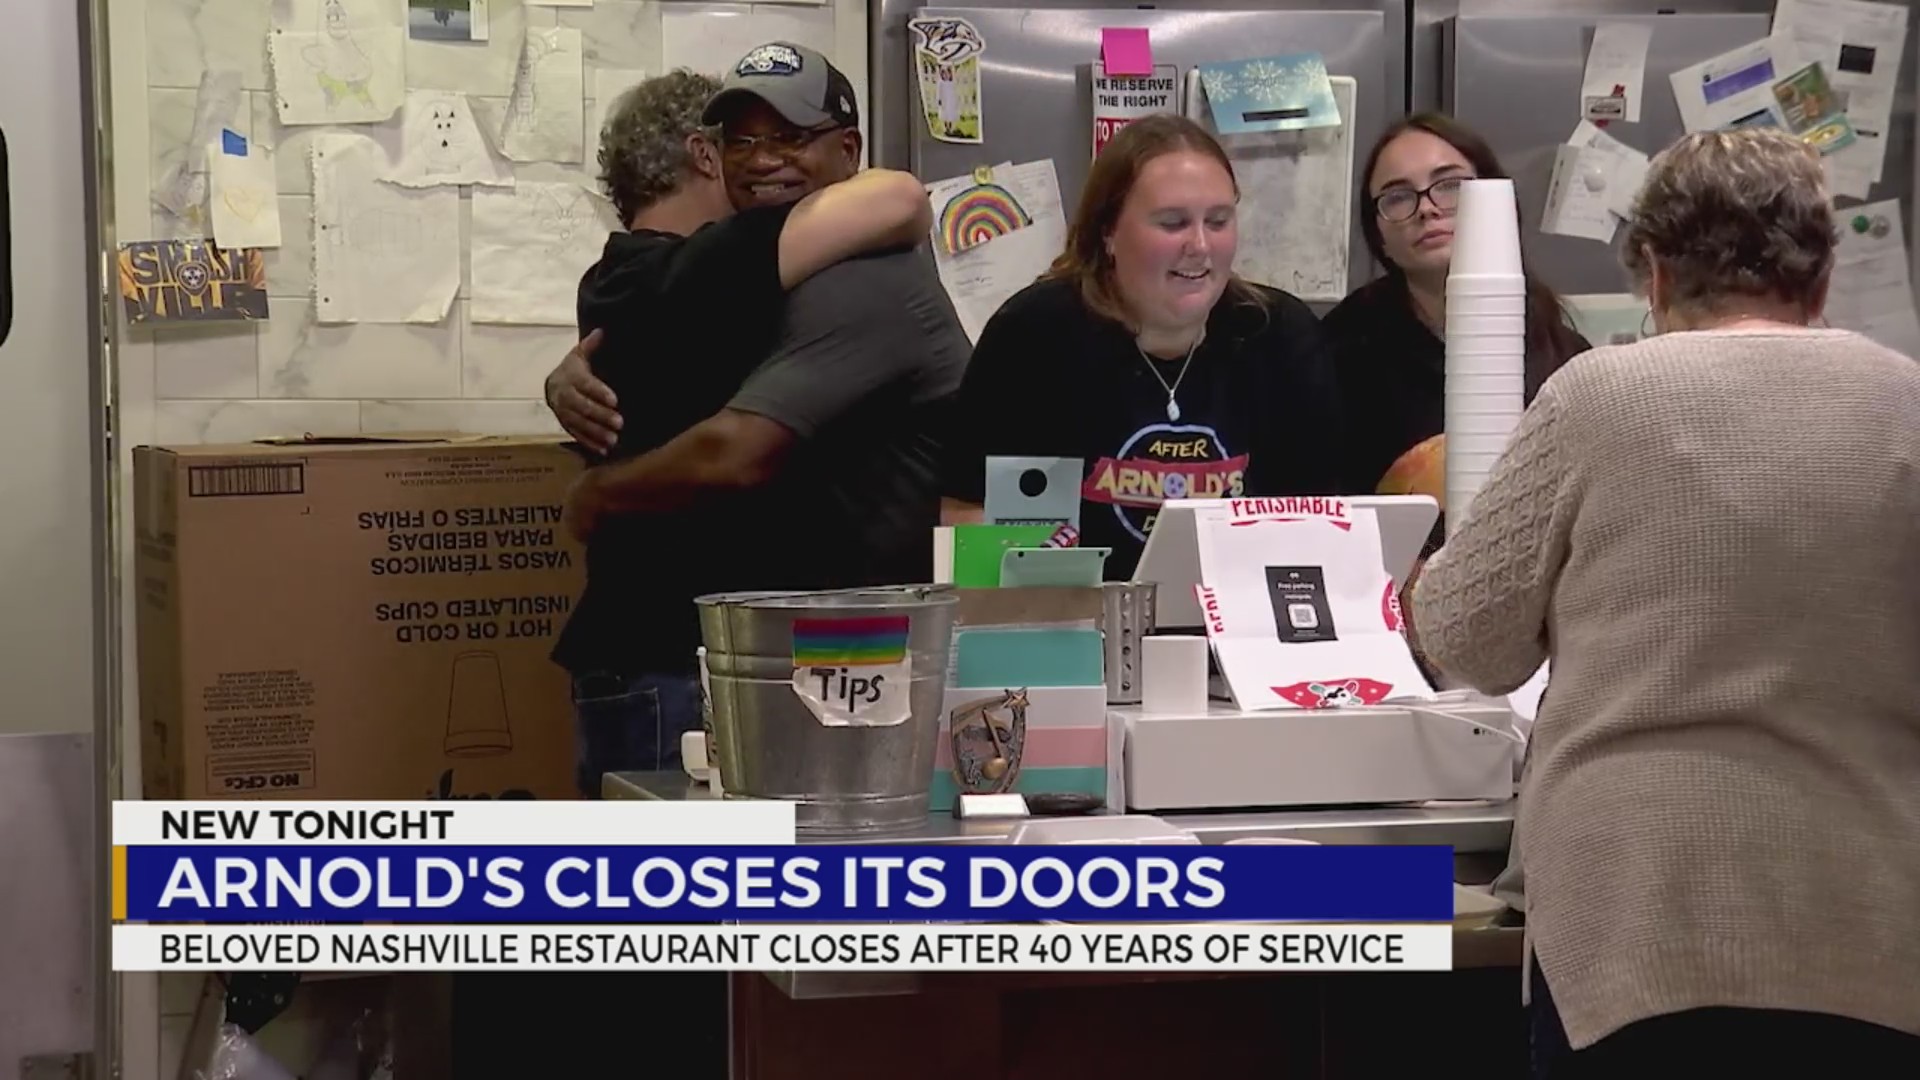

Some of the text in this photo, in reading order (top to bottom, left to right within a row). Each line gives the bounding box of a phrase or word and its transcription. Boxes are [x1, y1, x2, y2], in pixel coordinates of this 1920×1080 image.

[1111, 79, 1173, 91] RESERVE
[1099, 95, 1167, 107] THE RIGHT
[130, 241, 248, 285] SMASH
[1149, 438, 1208, 458] AFTER
[1095, 463, 1244, 498] ARNOLD'S
[1231, 497, 1345, 517] PERISHABLE
[358, 505, 564, 533] ALIENTES O FRÍAS
[387, 528, 554, 551] PARA BEBIDAS
[371, 551, 573, 576] VASOS TÉRMICOS
[375, 596, 570, 621] INSULATED CUPS
[396, 619, 551, 642] HOT OR COLD
[810, 667, 884, 713] Tips
[270, 773, 299, 787] NO
